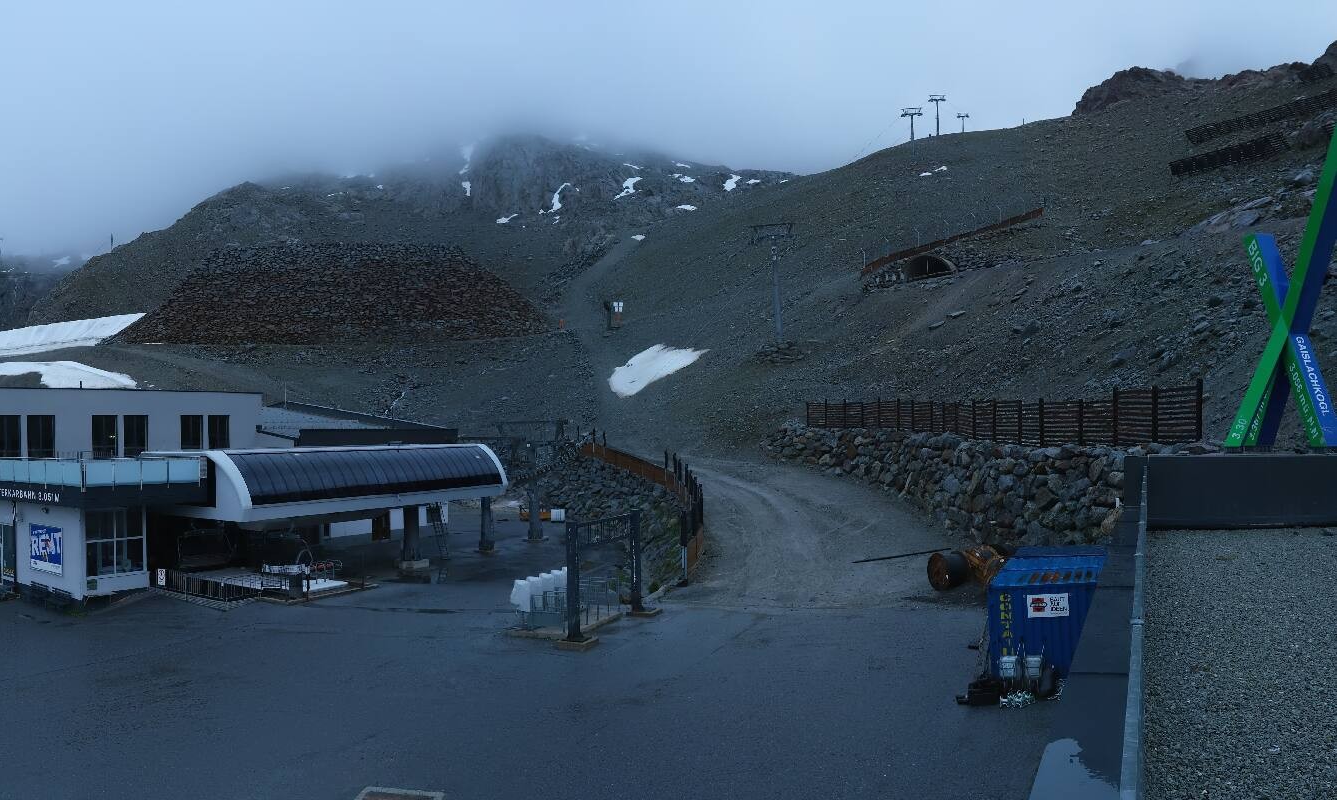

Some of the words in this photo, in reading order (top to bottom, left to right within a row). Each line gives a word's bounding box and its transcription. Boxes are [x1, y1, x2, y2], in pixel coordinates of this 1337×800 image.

[1247, 239, 1263, 273] BIG
[1258, 272, 1268, 287] 3
[1295, 336, 1330, 416] GAISLACHKOGL
